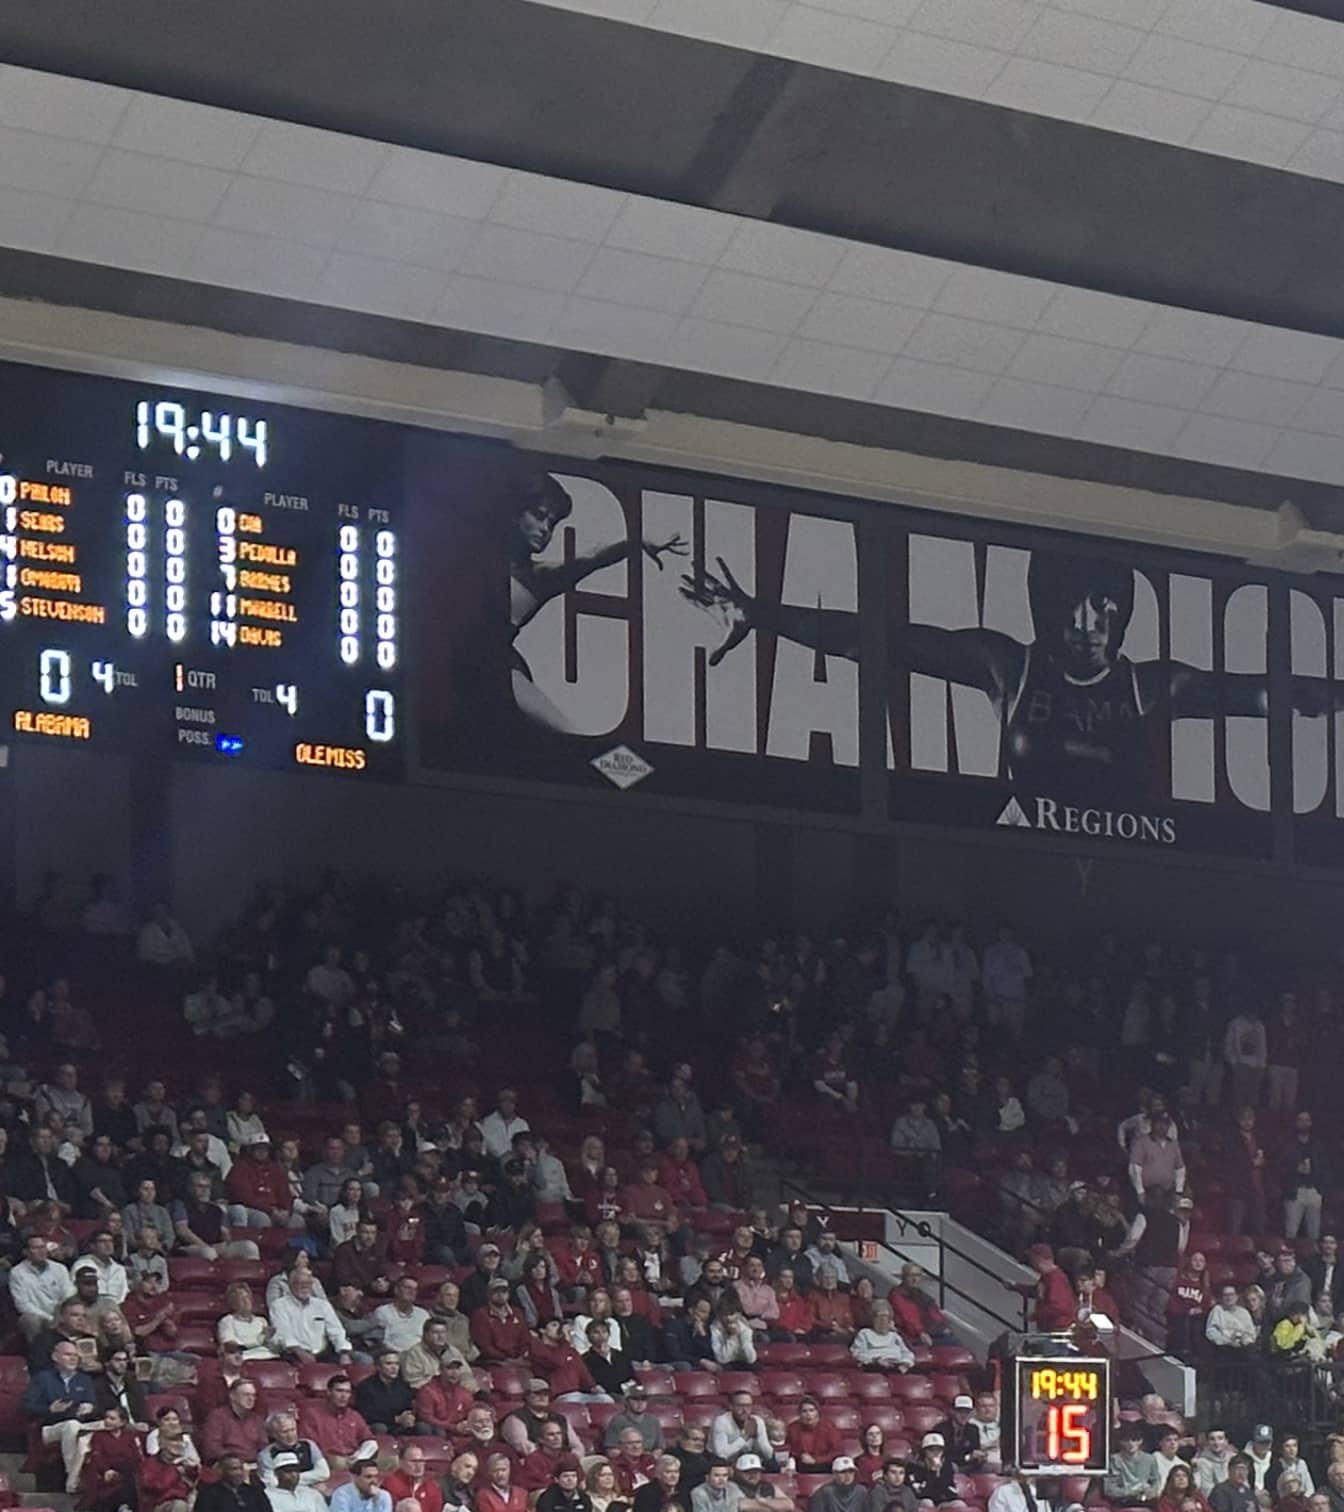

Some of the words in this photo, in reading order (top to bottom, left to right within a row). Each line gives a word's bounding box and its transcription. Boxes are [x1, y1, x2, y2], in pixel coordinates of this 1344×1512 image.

[136, 401, 268, 467] 19:44
[46, 460, 94, 479] PLAYER
[124, 471, 146, 487] FLS
[155, 476, 179, 491] PTS
[127, 493, 146, 521] 0
[166, 499, 184, 527] 0
[264, 492, 309, 511] PLAYER
[338, 504, 359, 519] FLS
[368, 508, 390, 523] PTS
[127, 523, 146, 549] 0
[166, 528, 184, 555] 0
[217, 507, 236, 535] 0
[340, 525, 358, 552] 0
[377, 530, 394, 558] 0
[127, 551, 146, 578] 0
[166, 557, 185, 584] 0
[218, 536, 236, 563] 3
[340, 553, 358, 580] 0
[377, 559, 394, 585] 0
[128, 580, 146, 606] 0
[167, 585, 185, 612] 0
[340, 581, 358, 607] 0
[377, 586, 395, 612] 0
[128, 608, 147, 636] 0
[167, 613, 186, 641] 0
[340, 608, 358, 634] 0
[377, 613, 395, 640] 0
[210, 620, 237, 647] 14
[341, 636, 359, 664] 0
[377, 640, 395, 669] 0
[39, 649, 71, 704] 0
[92, 661, 115, 694] 4
[175, 664, 184, 692] 1
[188, 672, 216, 690] QTR
[175, 706, 216, 725] BONUS
[275, 684, 297, 715] 4
[365, 690, 394, 742] 0
[1036, 797, 1176, 843] REGIONS
[1031, 1369, 1097, 1399] 19:44
[1049, 1404, 1090, 1461] 15
